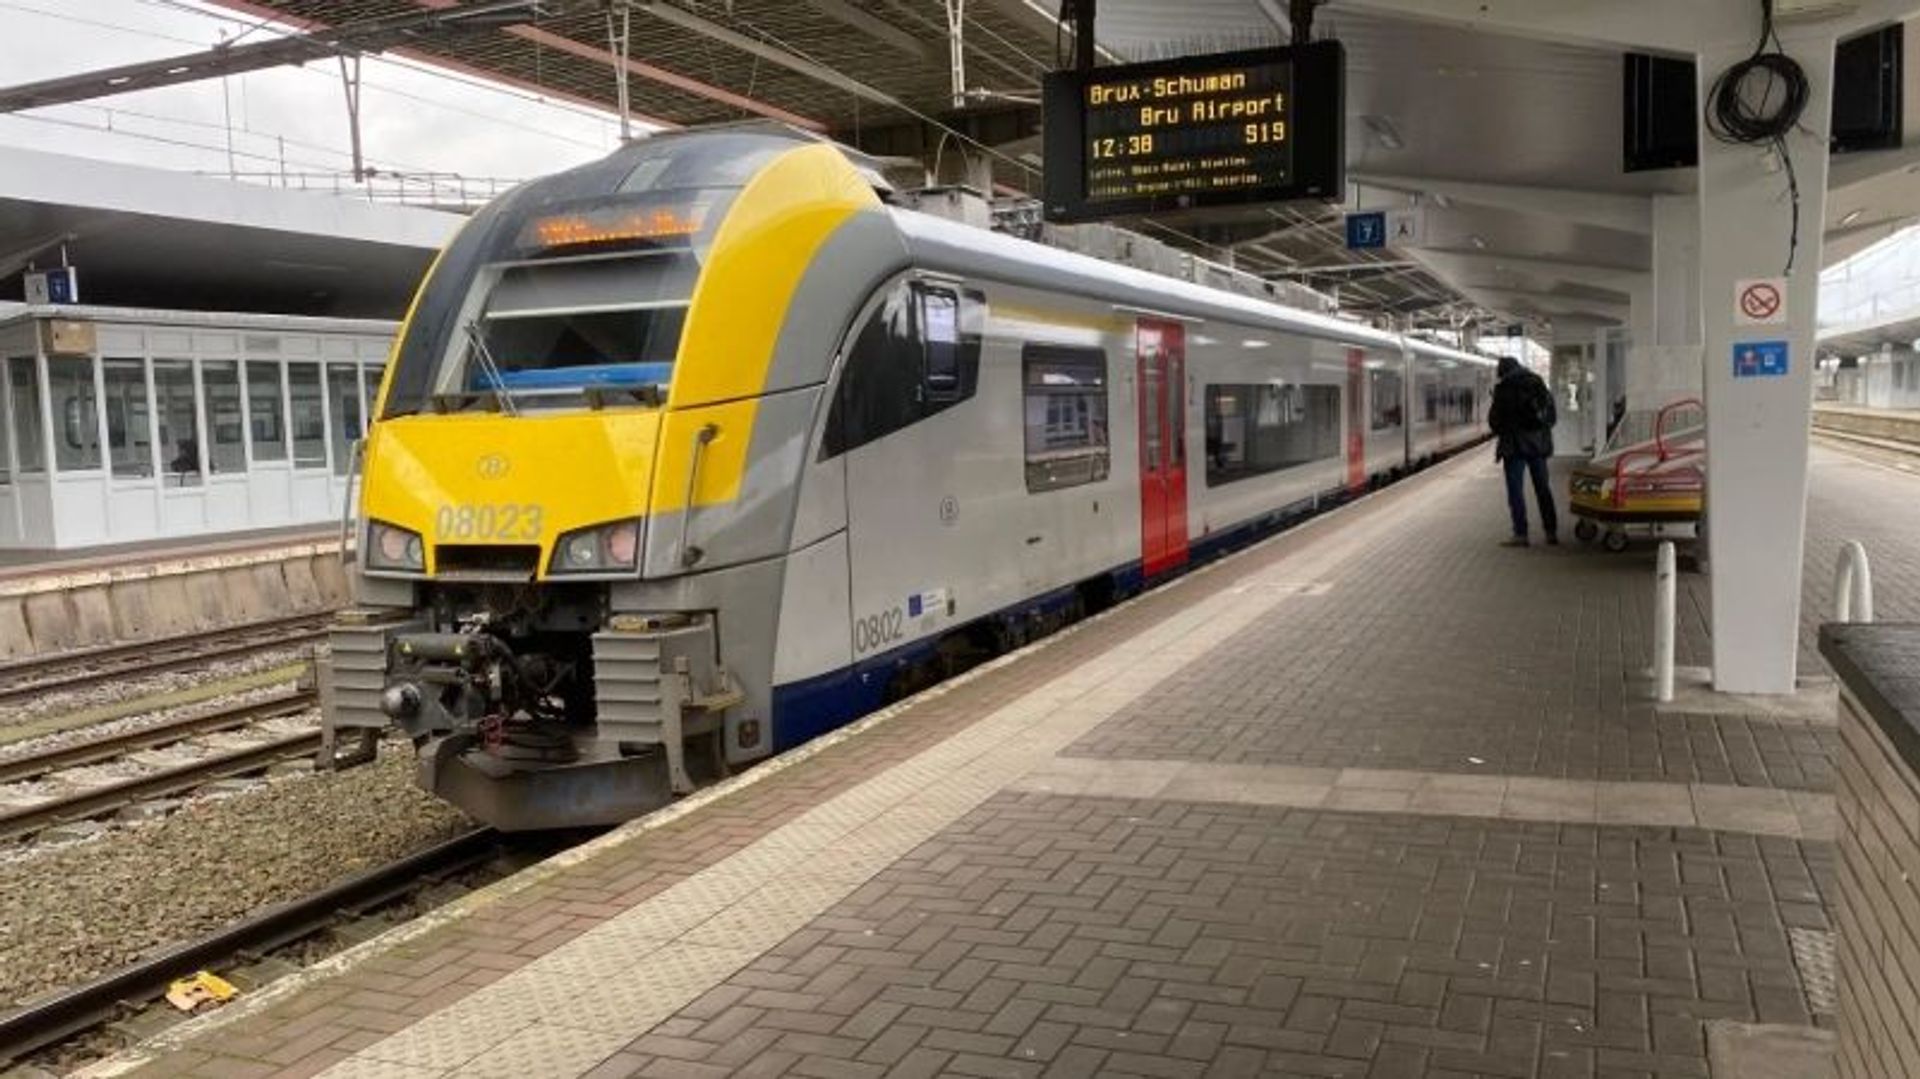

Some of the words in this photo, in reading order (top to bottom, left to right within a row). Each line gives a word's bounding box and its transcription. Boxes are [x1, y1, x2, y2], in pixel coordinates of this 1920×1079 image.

[1090, 73, 1246, 104] Brux-Schuman
[1141, 107, 1179, 126] Bru
[1192, 93, 1285, 121] Airport
[1092, 134, 1153, 159] 12:38
[1245, 122, 1285, 143] S19
[435, 503, 543, 540] 08023
[856, 606, 902, 653] 0802
